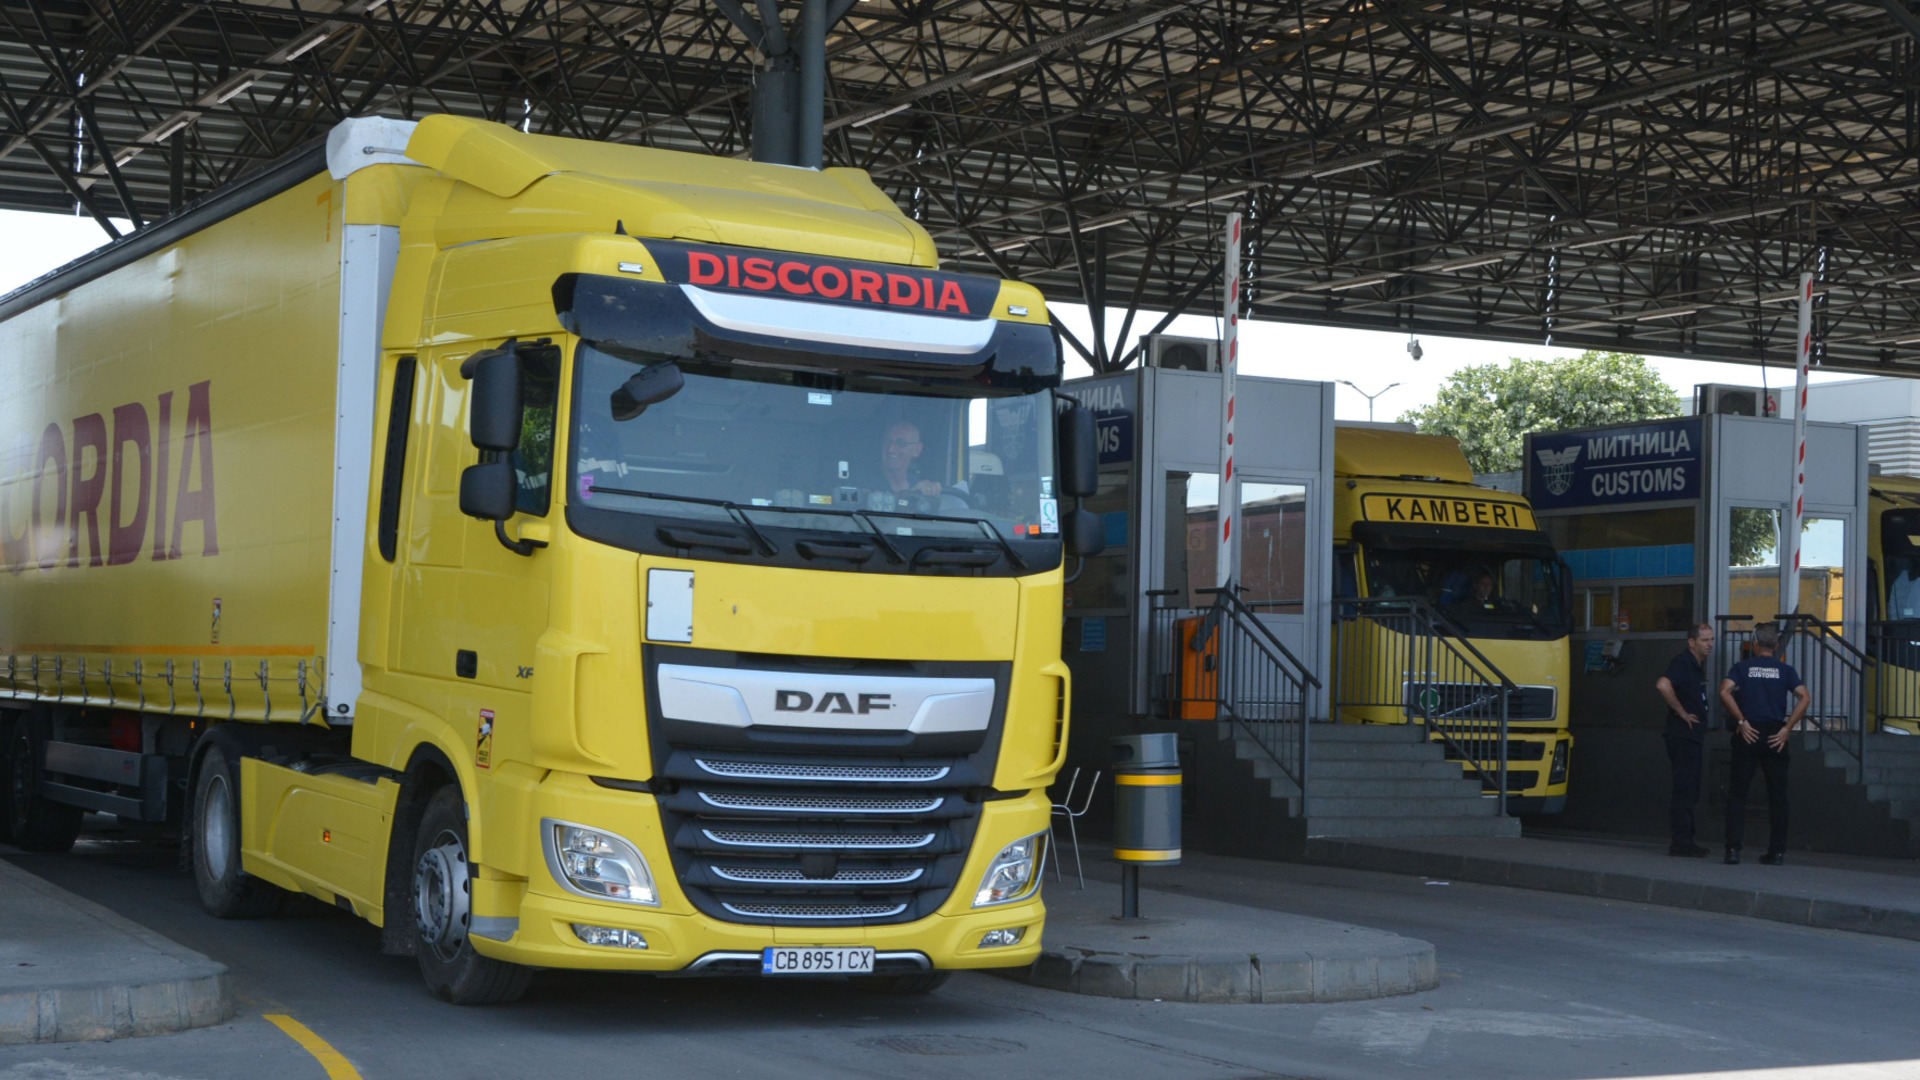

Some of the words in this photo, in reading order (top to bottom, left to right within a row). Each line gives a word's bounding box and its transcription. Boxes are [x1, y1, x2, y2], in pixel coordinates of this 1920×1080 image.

[687, 251, 970, 314] DISCORDIA
[1587, 429, 1691, 460] МИТНИЦА
[1591, 467, 1685, 497] CUSTOMS
[1386, 498, 1519, 528] KAMBERI
[516, 665, 534, 679] XF
[774, 689, 891, 715] DAF
[775, 951, 799, 970] CB
[802, 951, 844, 970] 8951
[848, 951, 870, 970] CX
